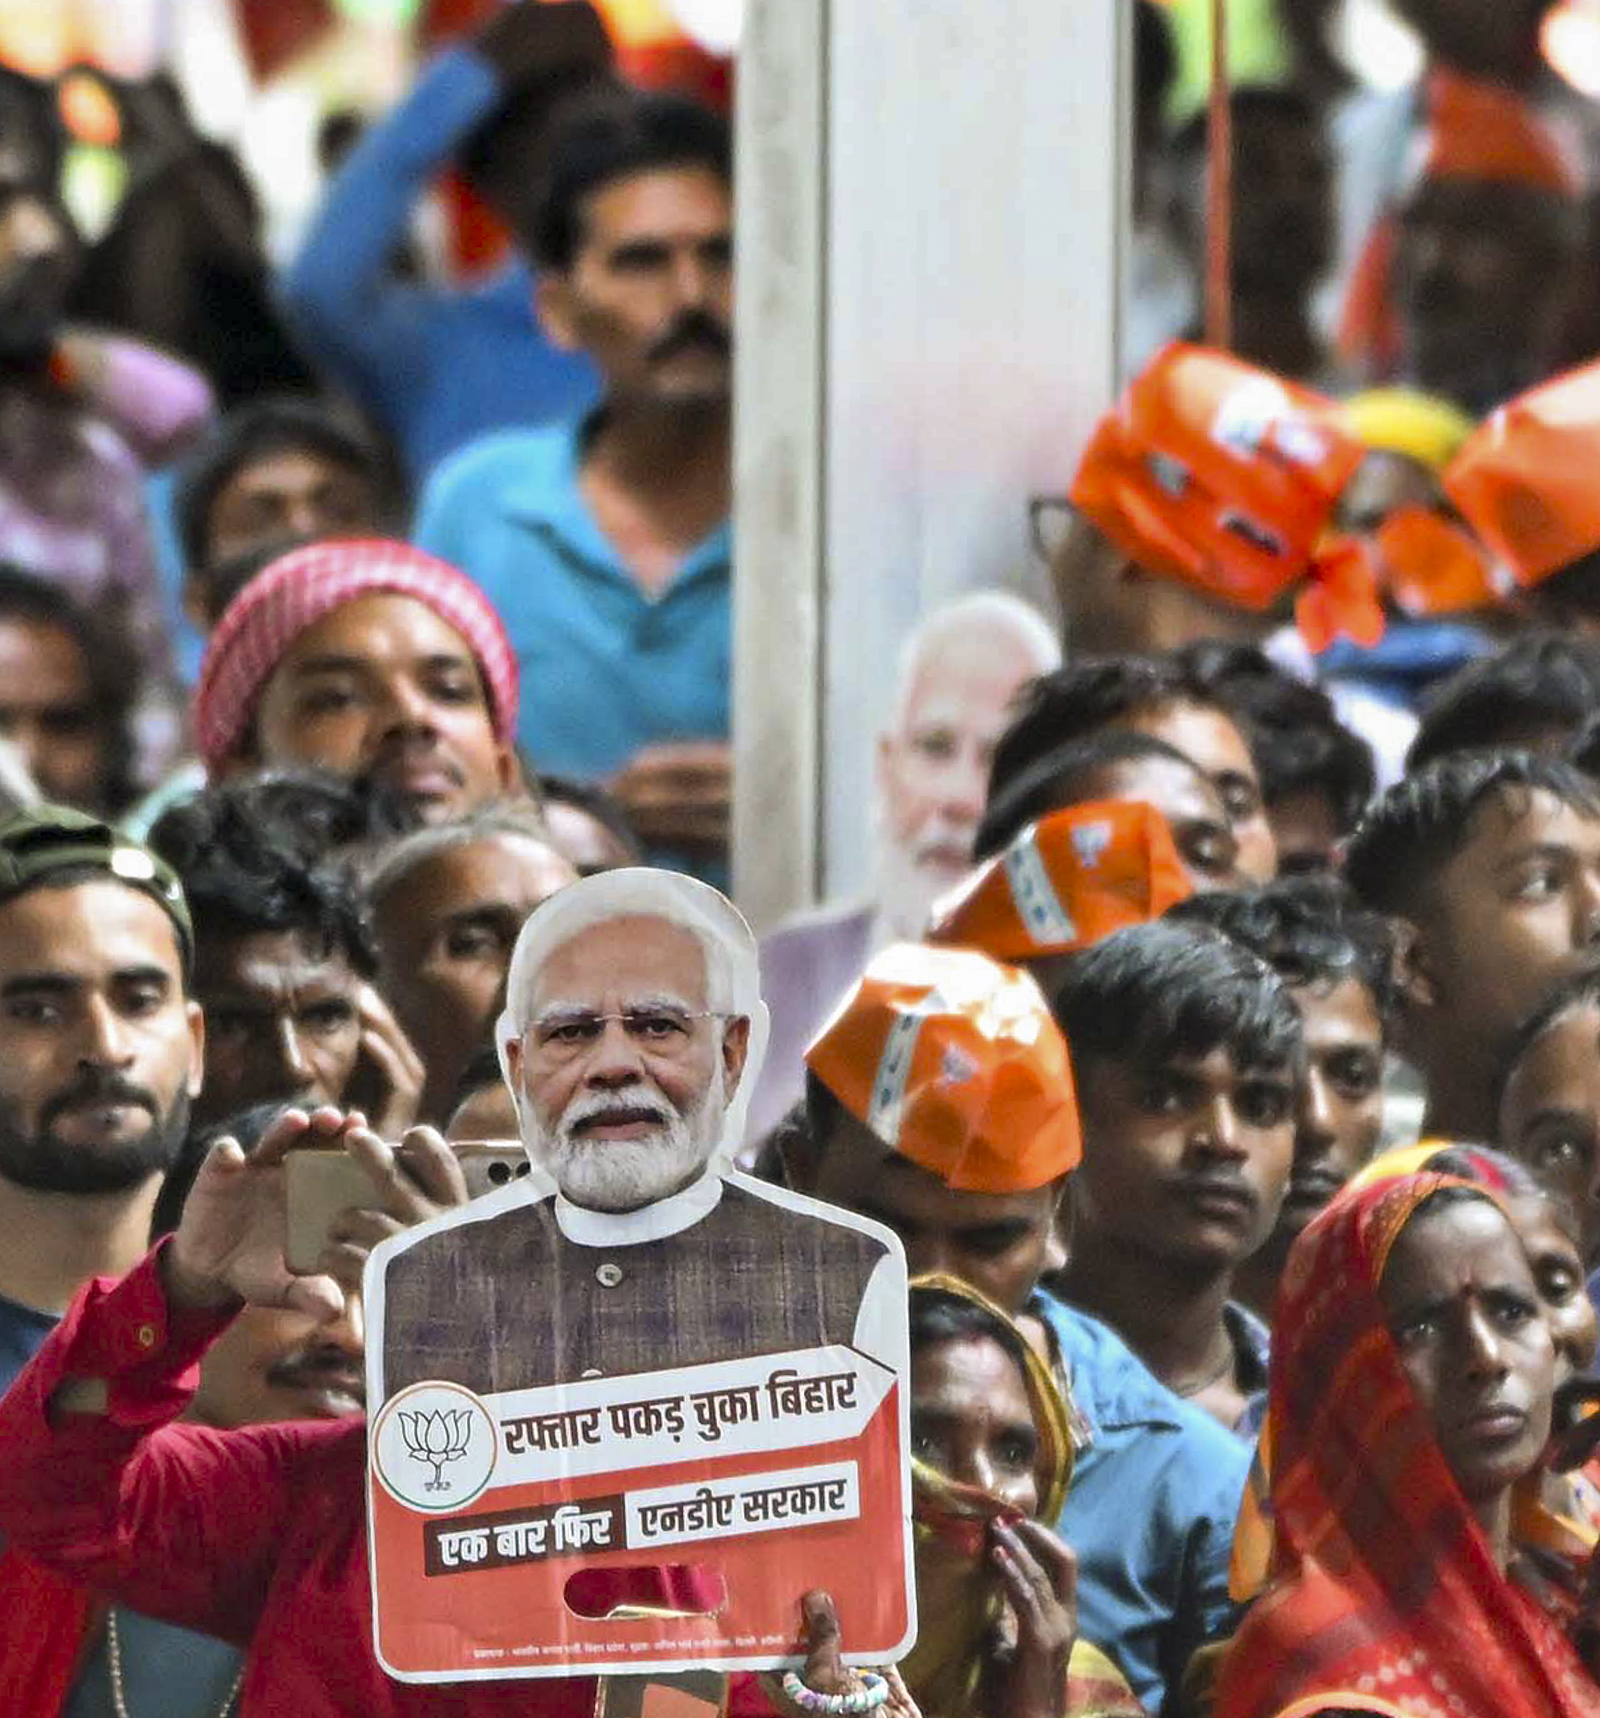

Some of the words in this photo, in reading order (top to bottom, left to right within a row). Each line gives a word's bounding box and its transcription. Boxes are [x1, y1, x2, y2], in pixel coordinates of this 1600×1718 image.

[500, 1407, 602, 1455] रफ्तार
[608, 1396, 686, 1444] पकड़
[690, 1385, 760, 1442] चुका
[765, 1368, 859, 1420] बिहार
[438, 1528, 489, 1565] एक
[495, 1521, 549, 1559] बार
[552, 1505, 614, 1551] फिर
[638, 1488, 736, 1536] एनडीए
[741, 1478, 848, 1520] सरकार
